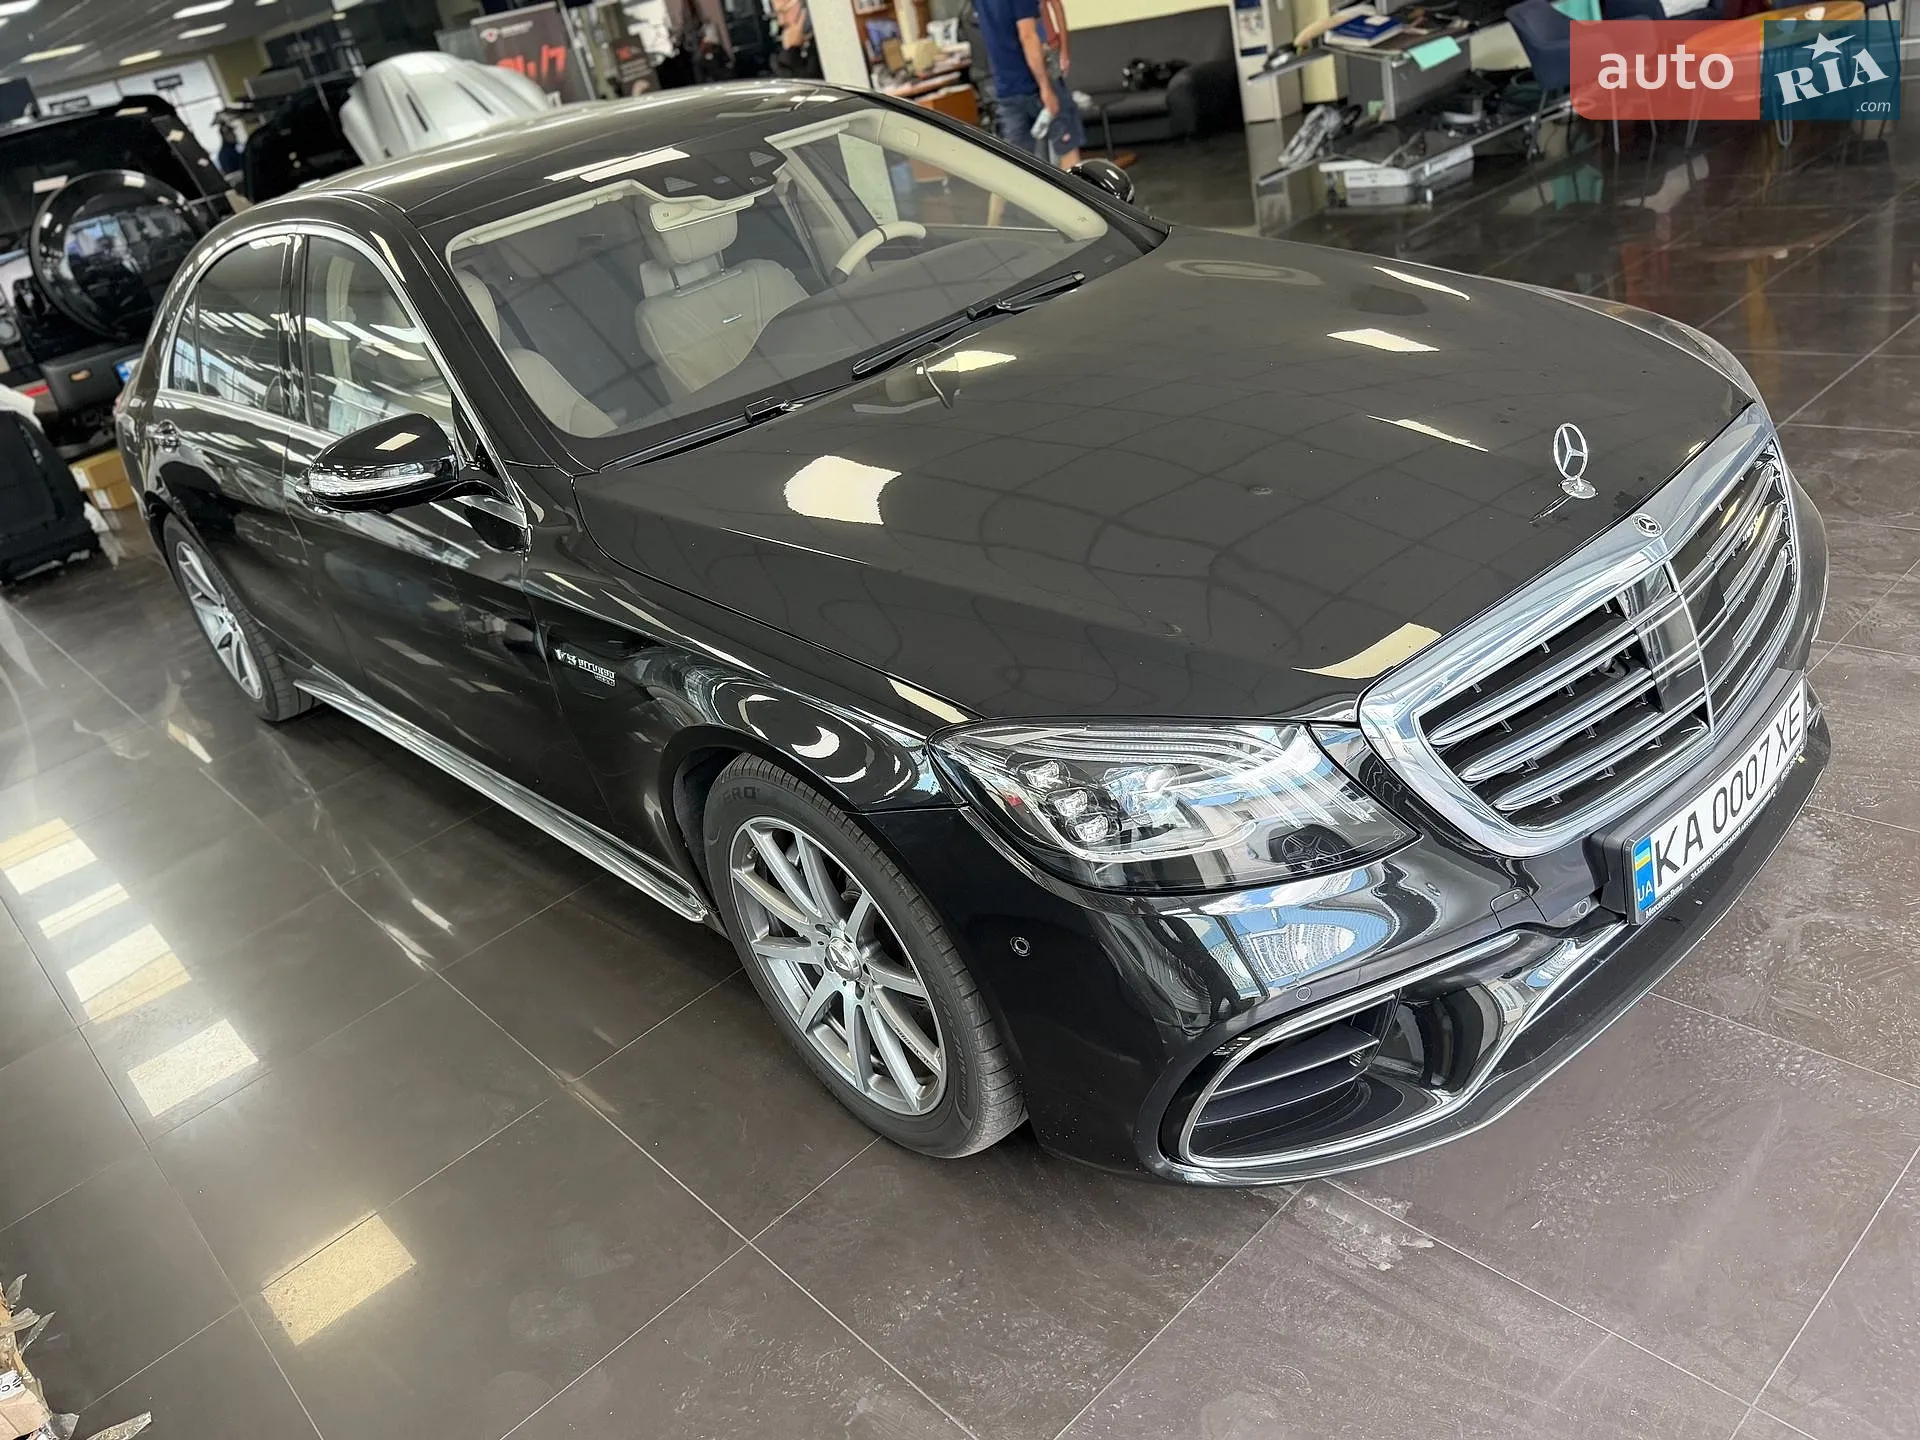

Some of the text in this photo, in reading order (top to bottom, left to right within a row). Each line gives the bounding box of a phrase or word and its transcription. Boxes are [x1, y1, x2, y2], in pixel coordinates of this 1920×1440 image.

[1654, 810, 1704, 888] KA
[1712, 733, 1770, 835] 0007
[1775, 691, 1802, 768] XE
[1637, 880, 1654, 901] UA
